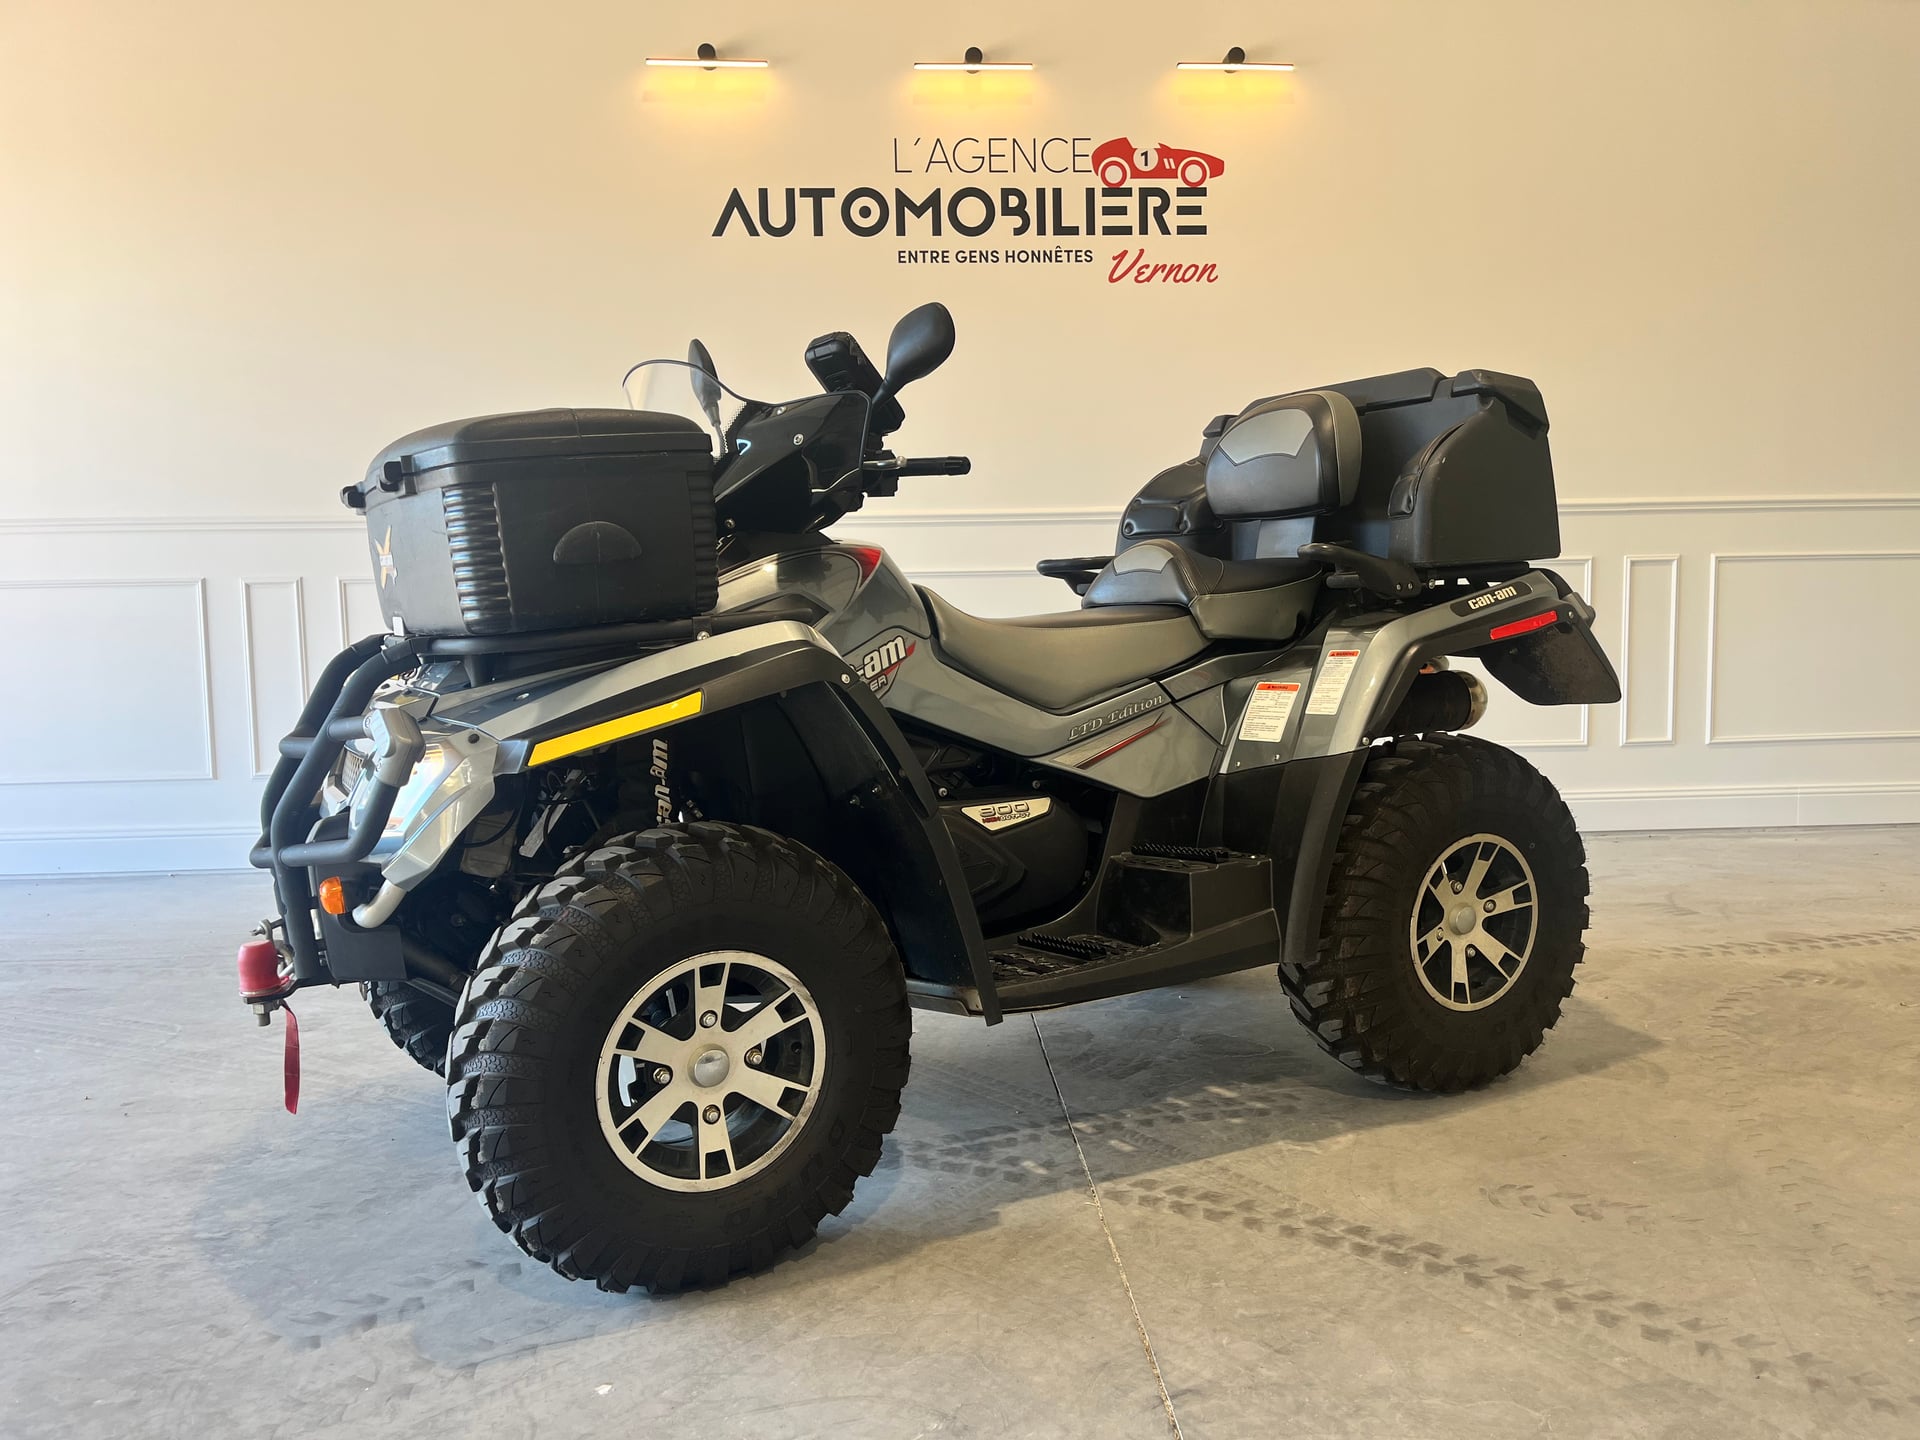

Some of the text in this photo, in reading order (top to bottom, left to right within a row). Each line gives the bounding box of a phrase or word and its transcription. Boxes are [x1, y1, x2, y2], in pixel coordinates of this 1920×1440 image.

[1140, 150, 1149, 167] 1
[711, 186, 1208, 237] AUTOMOBILIERE
[897, 245, 1094, 264] ENTRE GENS HONNÊTES
[1107, 247, 1219, 284] Vernon
[1467, 585, 1518, 610] can-am
[1067, 694, 1163, 741] LTD Edition
